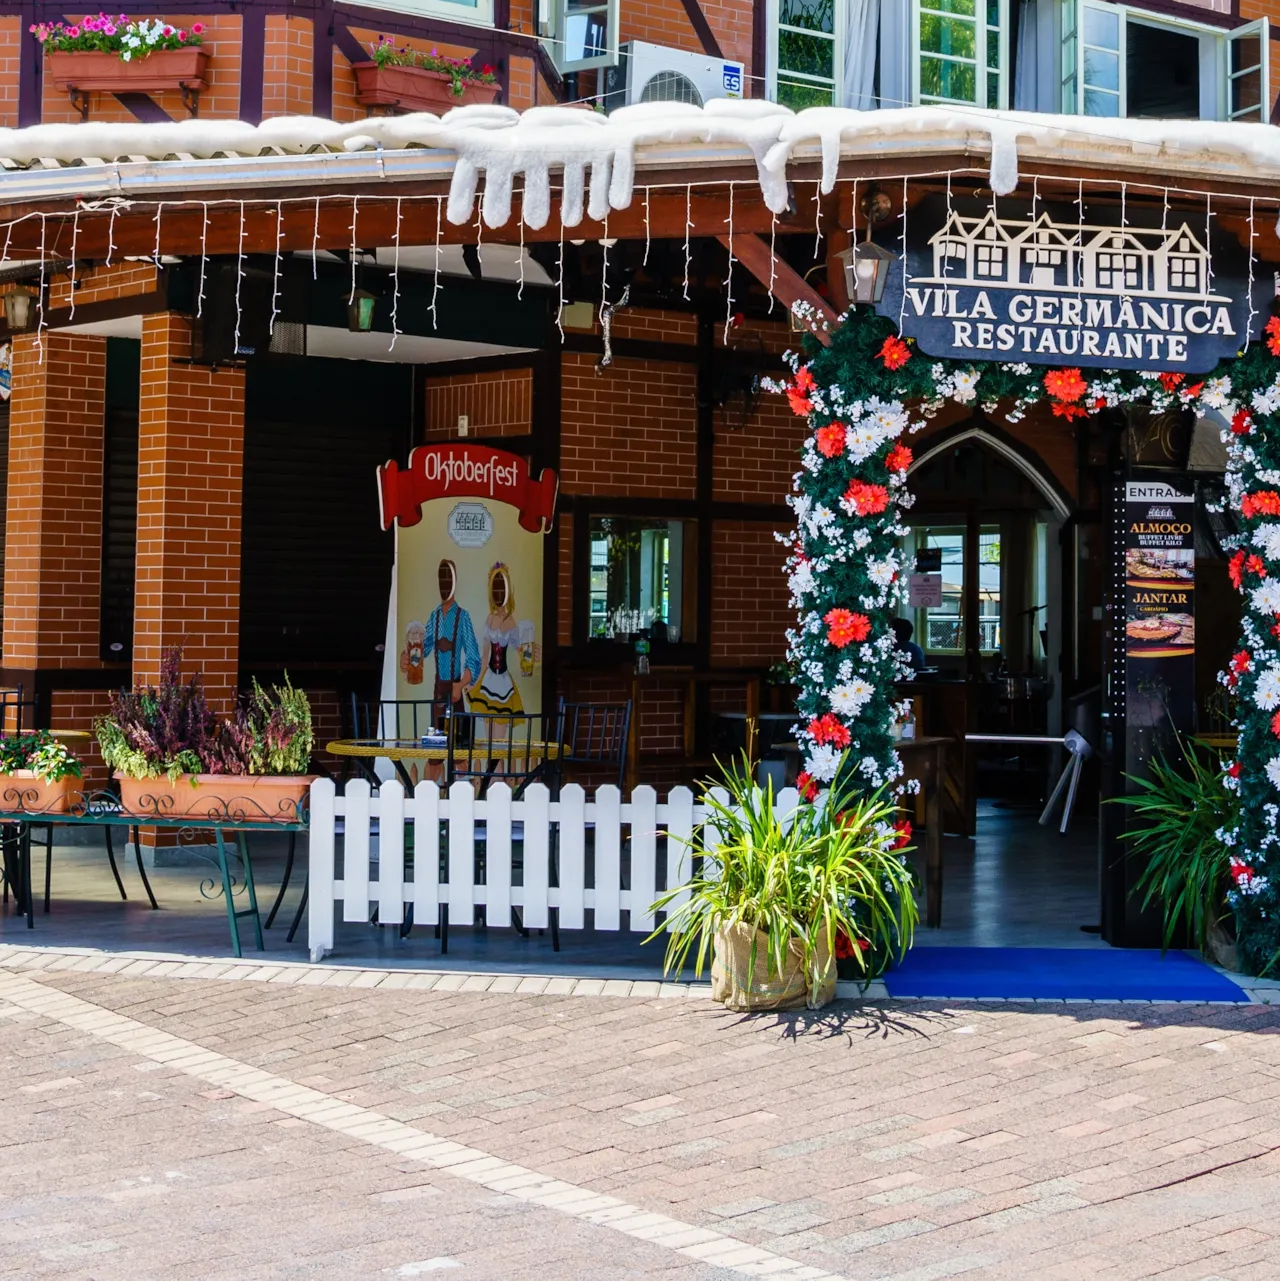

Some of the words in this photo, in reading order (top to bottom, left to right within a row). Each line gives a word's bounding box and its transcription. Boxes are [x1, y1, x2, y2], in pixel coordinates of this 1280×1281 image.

[906, 288, 998, 320] VILA
[1008, 295, 1237, 336] GERMÂNICA
[952, 321, 1189, 362] RESTAURANTE
[425, 452, 518, 495] Oktoberfest
[1130, 523, 1192, 536] ALMOÇO
[1132, 593, 1188, 604] JANTAR
